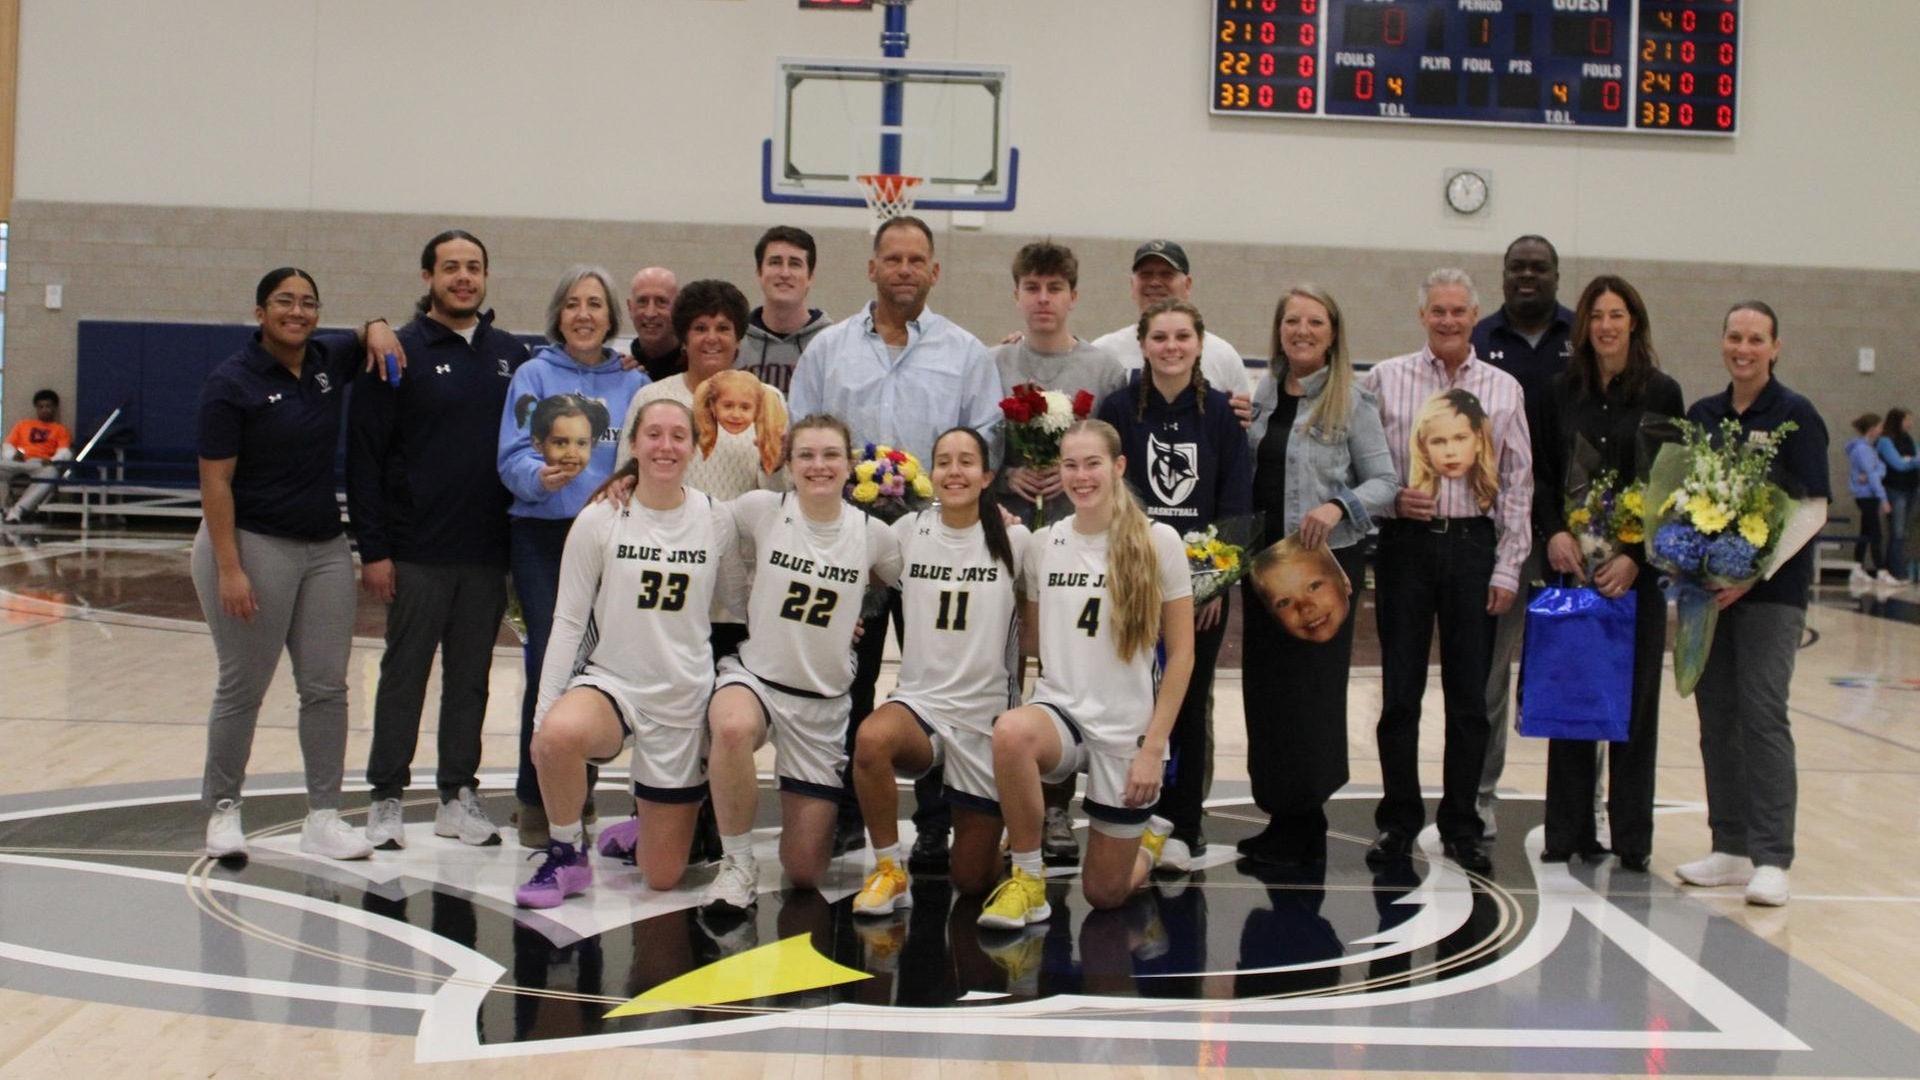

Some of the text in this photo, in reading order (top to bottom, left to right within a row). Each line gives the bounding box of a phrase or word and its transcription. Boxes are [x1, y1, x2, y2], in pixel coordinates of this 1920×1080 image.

[1458, 0, 1503, 12] PERIOD
[1553, 0, 1609, 12] GUEST
[1220, 20, 1315, 46] 21 0 0
[1480, 18, 1489, 44] 1
[1658, 9, 1735, 34] 4 0 0
[1220, 52, 1314, 78] 22 0 0
[1335, 52, 1376, 68] FOULS
[1420, 56, 1452, 71] PLYR
[1462, 57, 1494, 73] FOUL
[1642, 40, 1733, 65] 21 0 0
[1508, 60, 1532, 75] PTS
[1582, 63, 1622, 79] FOULS
[1355, 69, 1403, 100] 0 4
[1552, 81, 1620, 110] 4 0
[1642, 71, 1732, 96] 24 0 0
[1220, 83, 1313, 110] 33 0 0
[1379, 103, 1410, 117] T.O.L.
[1544, 110, 1575, 125] T.O.L.
[1642, 102, 1731, 128] 33 0 0
[1147, 506, 1199, 517] BASKETBALL
[616, 544, 707, 564] BLUE JAYS
[769, 550, 859, 584] BLUE JAYS
[909, 563, 998, 582] BLUE JAYS
[637, 570, 690, 612] 33
[1048, 572, 1089, 588] BLUE
[779, 580, 839, 629] 22
[935, 590, 970, 631] 11
[1077, 597, 1102, 637] 4
